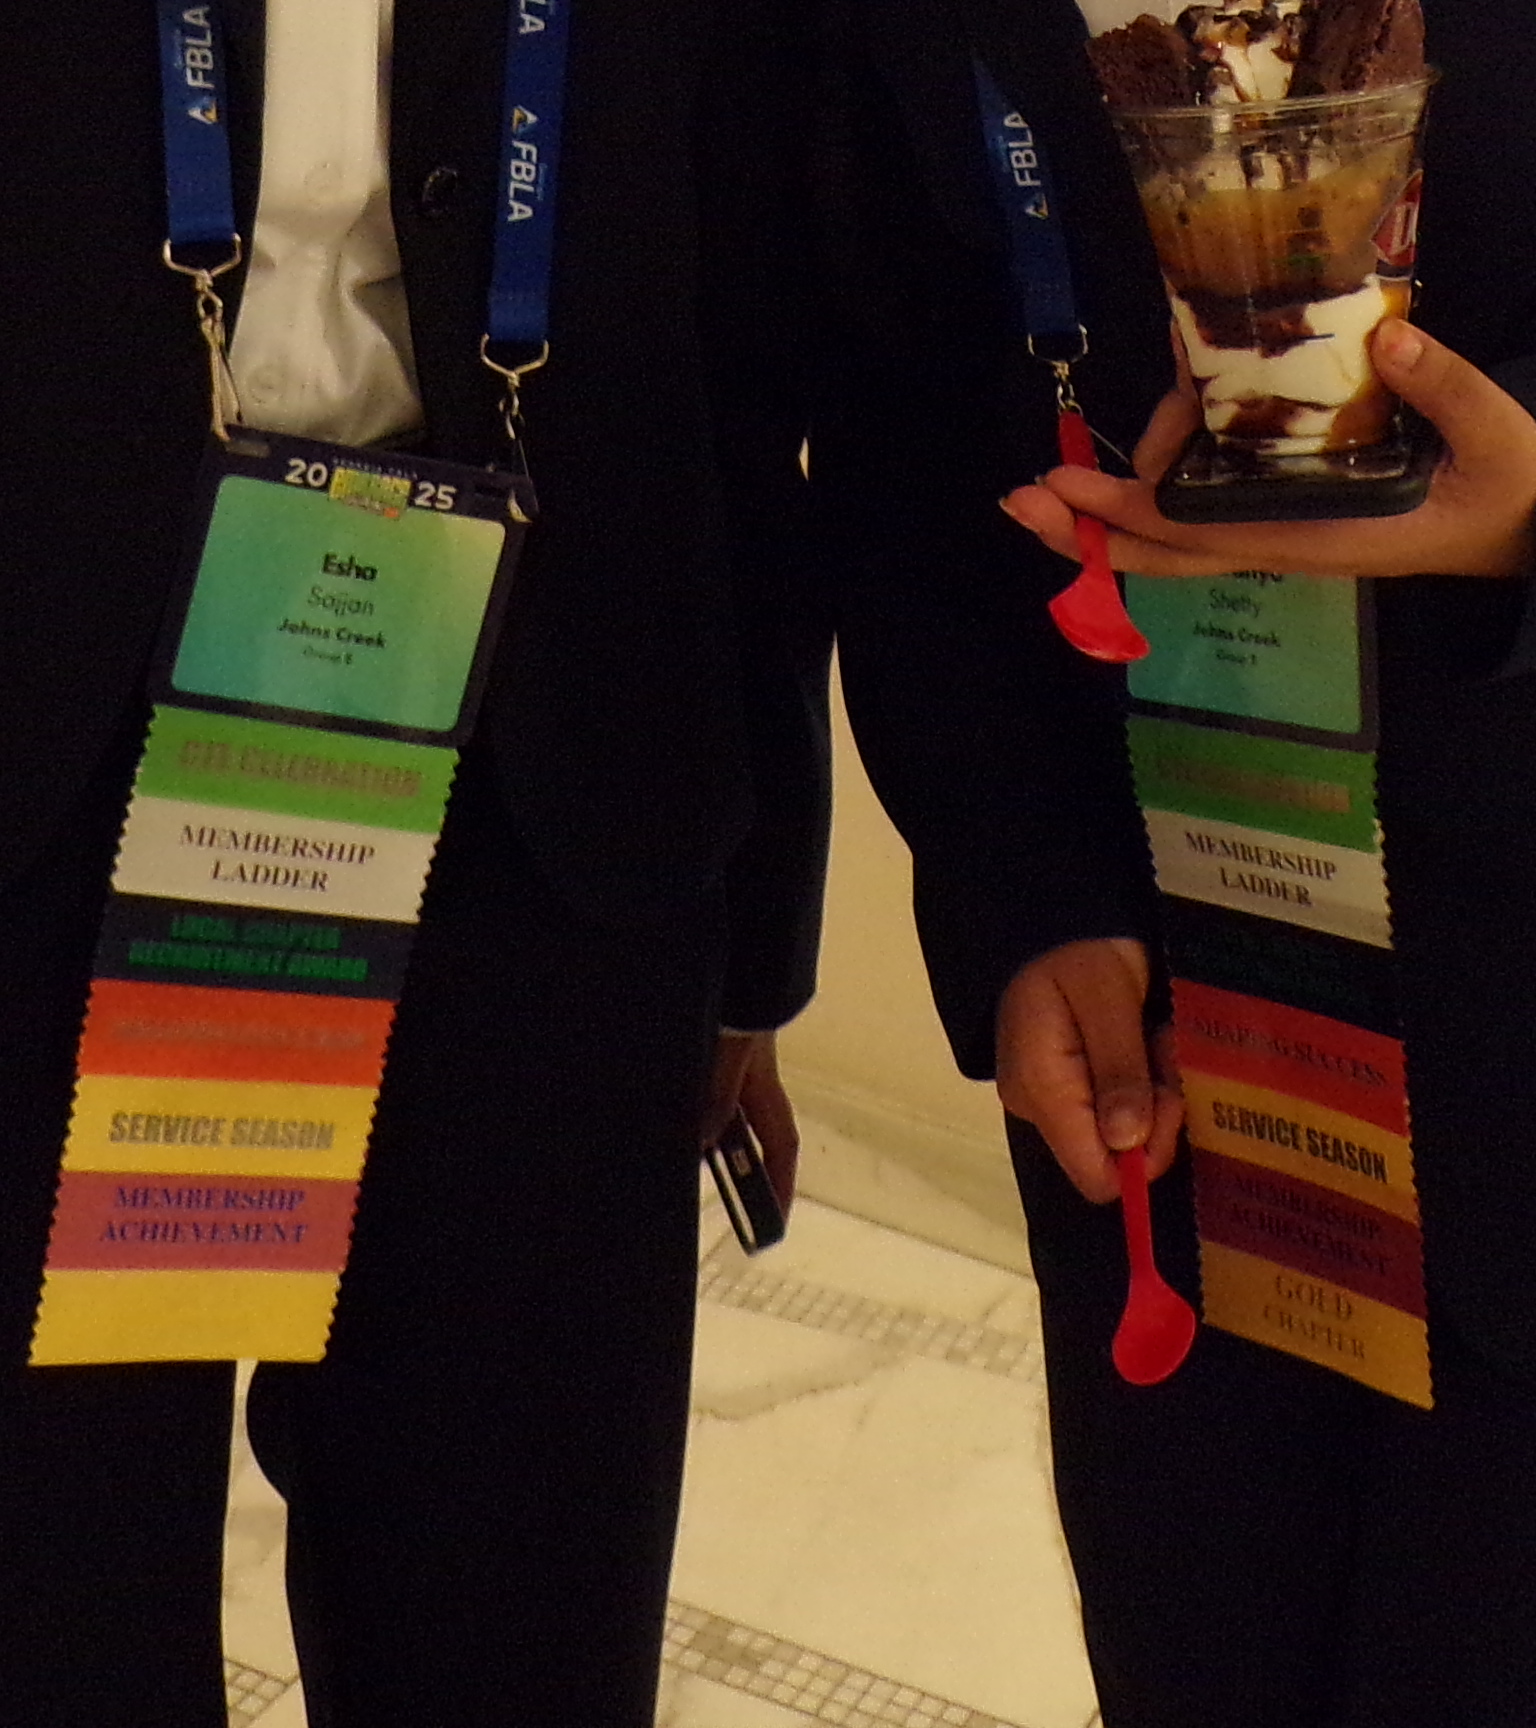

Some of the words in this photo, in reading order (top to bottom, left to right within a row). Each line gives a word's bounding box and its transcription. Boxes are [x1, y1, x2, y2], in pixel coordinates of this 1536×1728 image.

[182, 5, 215, 89] FBLA
[1004, 112, 1041, 186] FBLA
[507, 139, 537, 222] FBLA
[285, 458, 328, 487] 20
[414, 481, 457, 510] 25
[322, 552, 378, 582] Esha
[307, 585, 375, 617] Sajjan
[277, 617, 331, 640] Johns
[335, 626, 387, 649] Creek
[1237, 626, 1281, 648] Creek
[178, 824, 376, 866] MEMBERSHIP
[1184, 830, 1338, 881] MEMBERSHIP
[211, 860, 330, 893] LADDER
[1219, 866, 1312, 907] LADDER
[108, 1111, 226, 1148] SERVICE
[229, 1115, 337, 1151] SEASON
[1211, 1100, 1302, 1151] SERVICE
[1307, 1126, 1390, 1184] SEASON
[114, 1186, 307, 1212] MEMBERSHIP
[100, 1220, 309, 1245] ACHIEVEMENT
[1275, 1274, 1353, 1321] GOLD
[1263, 1304, 1365, 1359] CHAPTER
